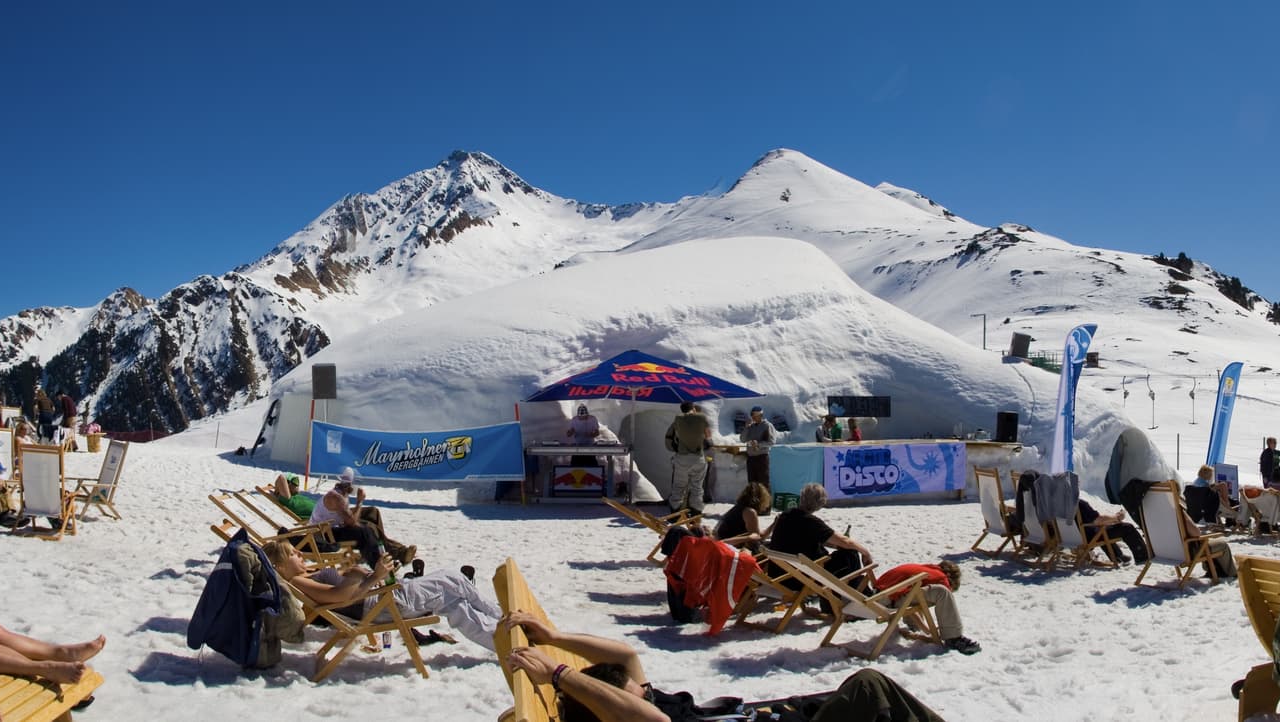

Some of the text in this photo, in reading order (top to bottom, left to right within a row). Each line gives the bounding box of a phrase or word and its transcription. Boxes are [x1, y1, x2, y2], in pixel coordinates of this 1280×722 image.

[611, 373, 711, 388] Red Bull
[393, 454, 445, 471] BERGBAHNEN
